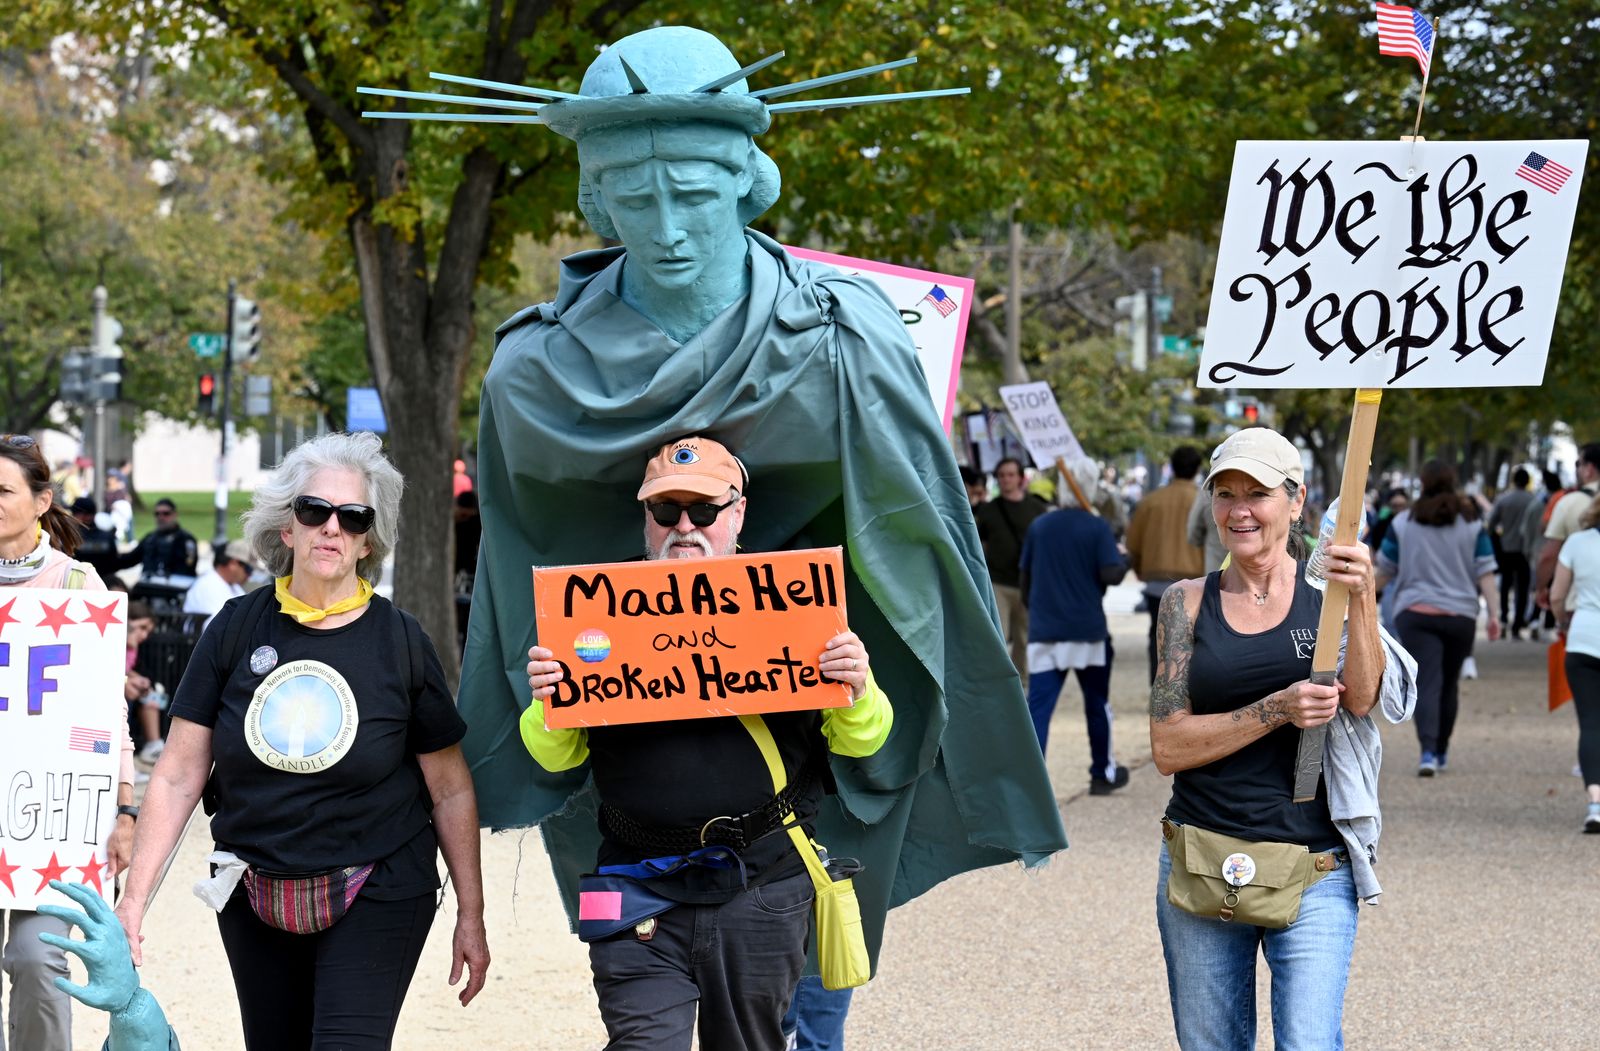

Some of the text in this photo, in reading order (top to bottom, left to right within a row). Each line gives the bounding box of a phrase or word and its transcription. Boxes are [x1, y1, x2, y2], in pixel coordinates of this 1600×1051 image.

[1256, 153, 1532, 270] We the
[1208, 260, 1526, 385] People
[1008, 390, 1050, 411] STOP
[1023, 413, 1059, 430] KING
[564, 562, 838, 617] Mad As Hell
[582, 635, 604, 645] LOVE
[1290, 628, 1316, 641] FEEL
[266, 668, 295, 689] Network
[293, 665, 303, 674] for
[303, 664, 337, 686] Democracy,
[255, 687, 270, 708] Action
[336, 682, 352, 714] Liberties
[250, 707, 262, 747] Community
[332, 726, 352, 753] Equality
[266, 752, 328, 772] CANDLE
[0, 770, 112, 845] GHT
